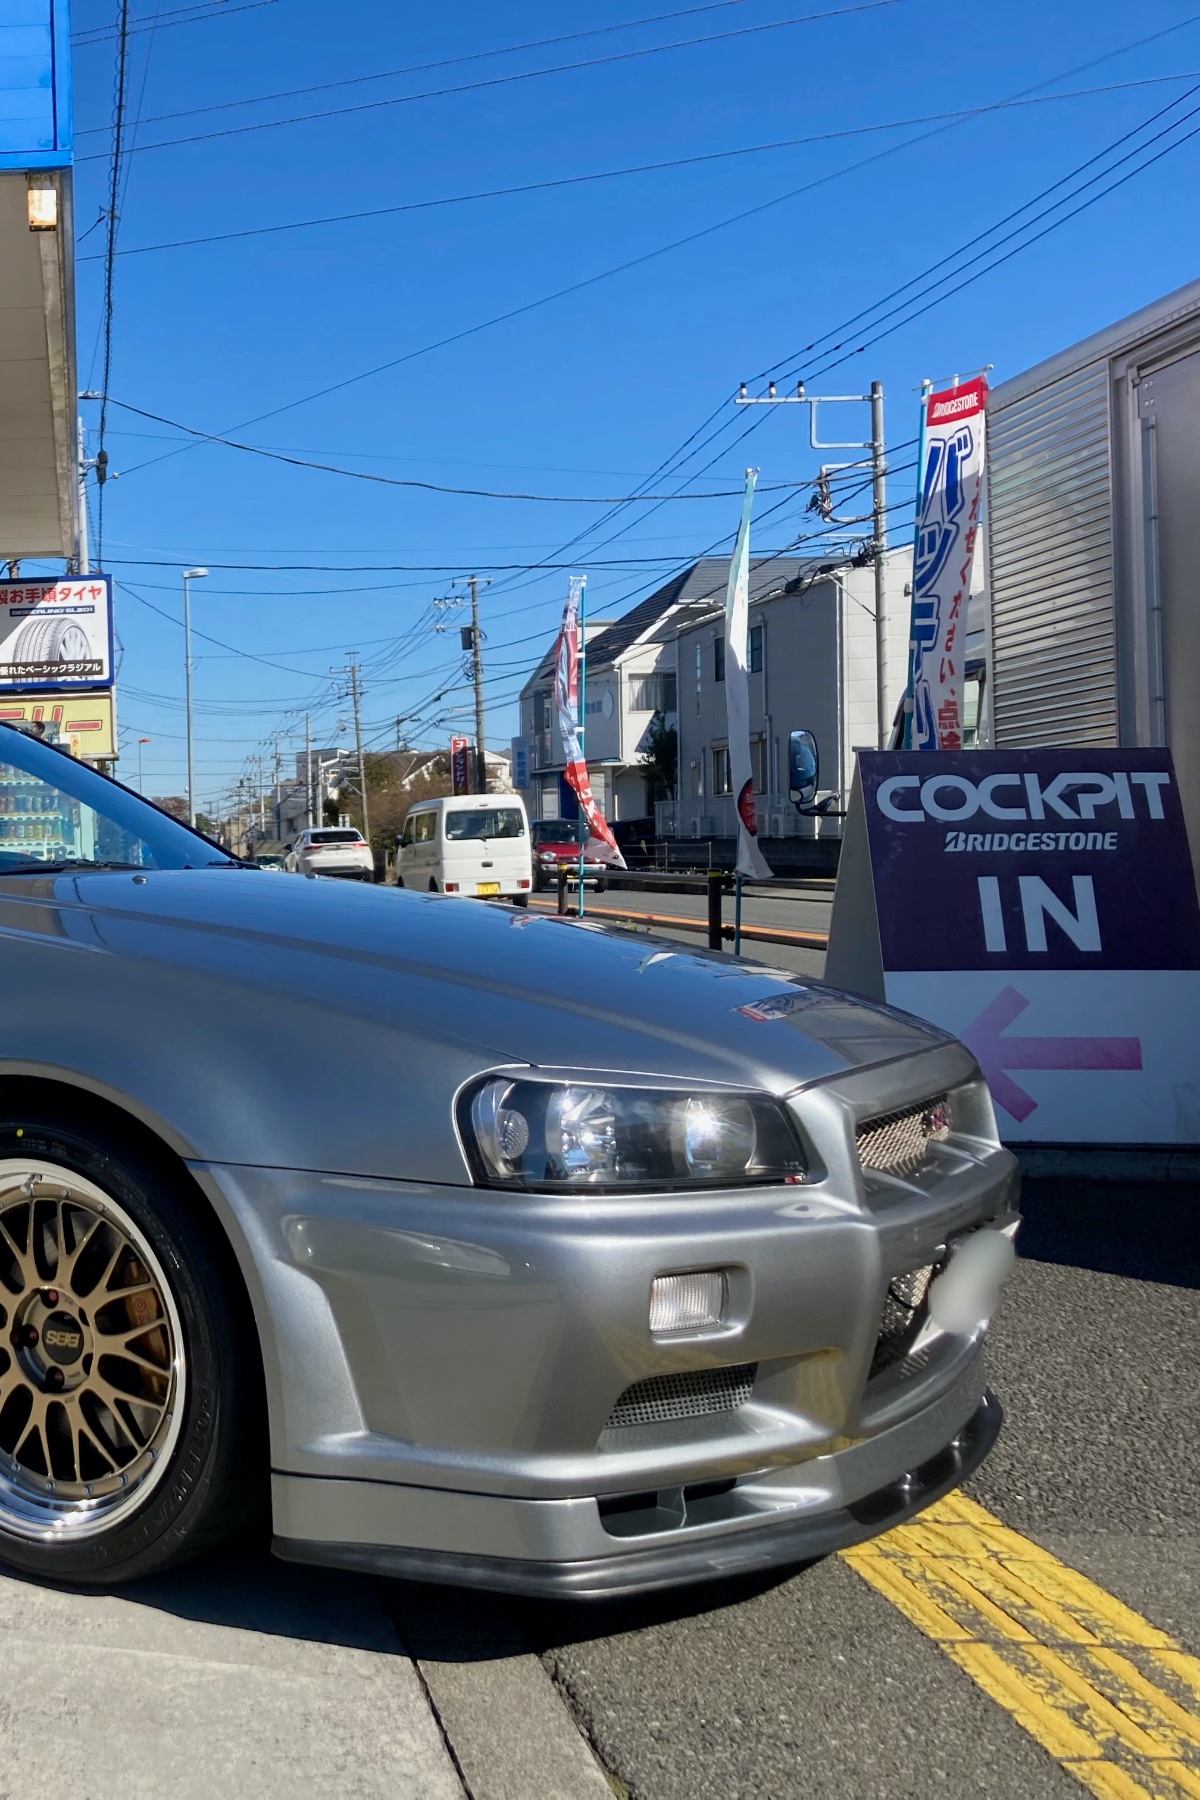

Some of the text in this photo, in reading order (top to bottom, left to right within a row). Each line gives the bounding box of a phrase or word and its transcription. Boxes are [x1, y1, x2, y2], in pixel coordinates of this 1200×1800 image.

[932, 391, 979, 418] BRIDGESTONE
[11, 606, 94, 616] SEIBERLING SL201
[876, 772, 1170, 823] COCKPIT
[944, 831, 1118, 852] BRIDGESTONE
[977, 875, 1102, 952] IN
[46, 1330, 80, 1348] BBS
